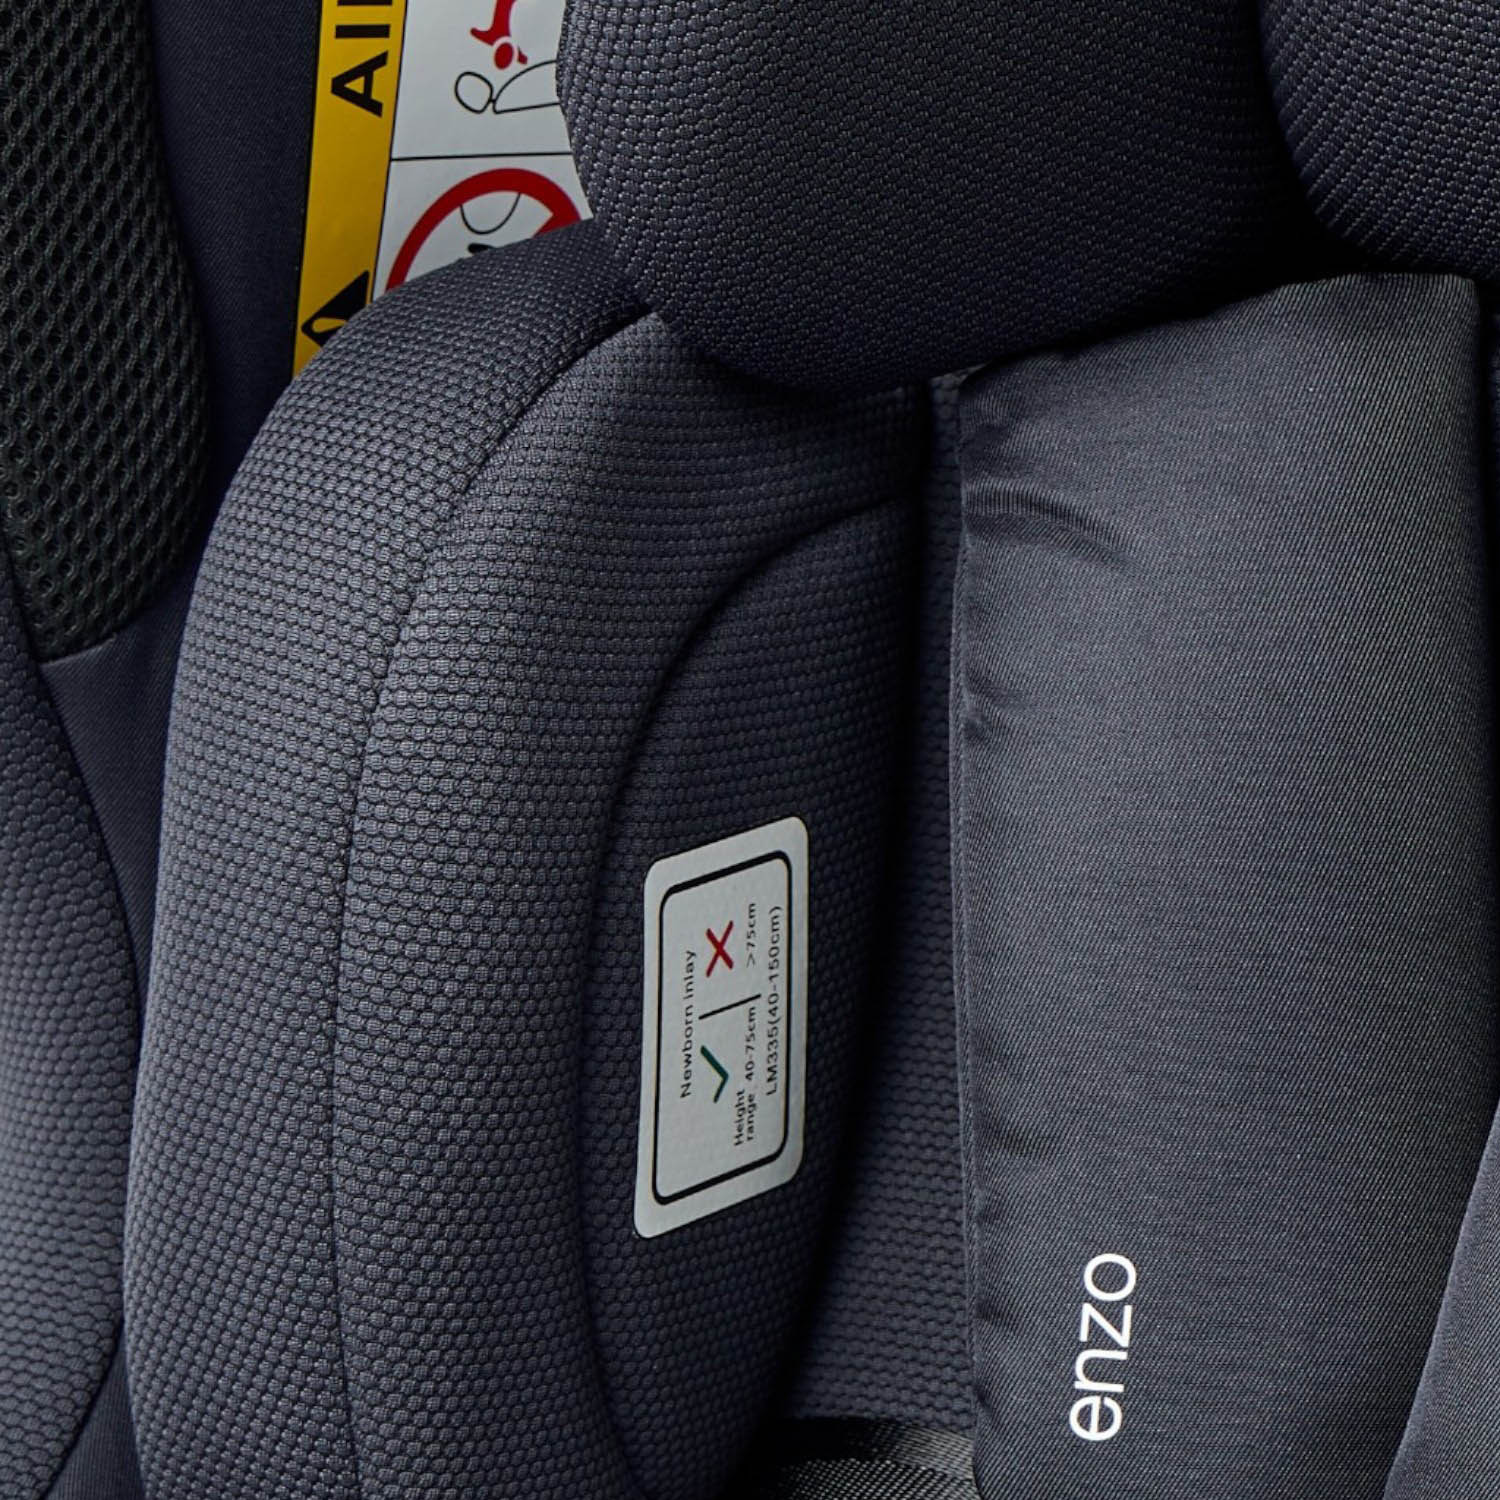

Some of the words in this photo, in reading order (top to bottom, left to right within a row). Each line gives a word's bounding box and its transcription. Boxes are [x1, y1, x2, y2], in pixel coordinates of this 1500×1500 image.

[330, 0, 393, 118] AI
[746, 903, 756, 968] >75cm
[683, 950, 697, 1000] inlay
[766, 906, 783, 1096] LM335(40-150cm)
[680, 1004, 694, 1098] Newborn
[745, 1006, 756, 1081] 40-75cm
[734, 1088, 746, 1146] Height
[747, 1094, 757, 1141] range
[1069, 1252, 1137, 1441] enzo
